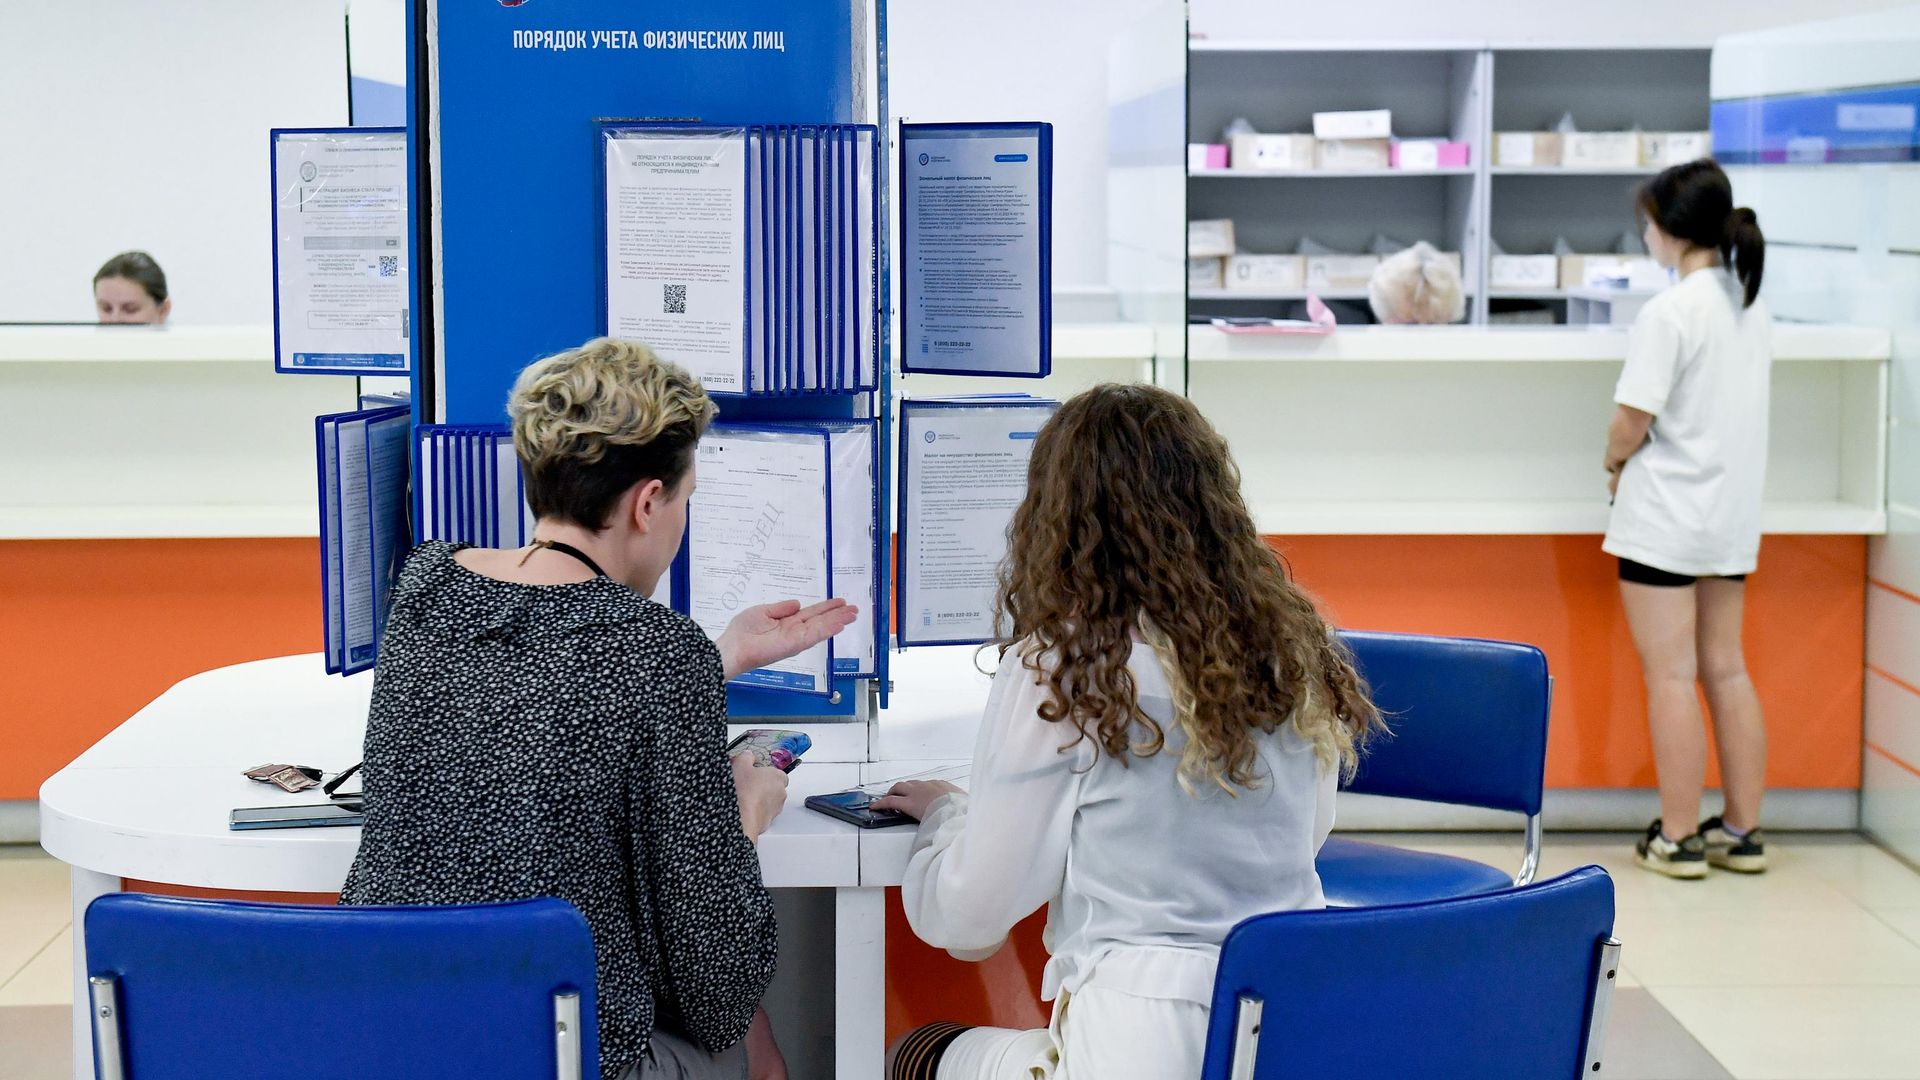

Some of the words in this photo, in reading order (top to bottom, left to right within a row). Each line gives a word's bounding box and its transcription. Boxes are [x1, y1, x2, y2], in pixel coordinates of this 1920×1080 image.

[513, 30, 586, 51] ПОРЯДОК
[591, 30, 638, 48] УЧЕТА
[643, 30, 747, 48] ФИЗИЧЕСКИХ
[752, 31, 785, 52] ЛИЦ
